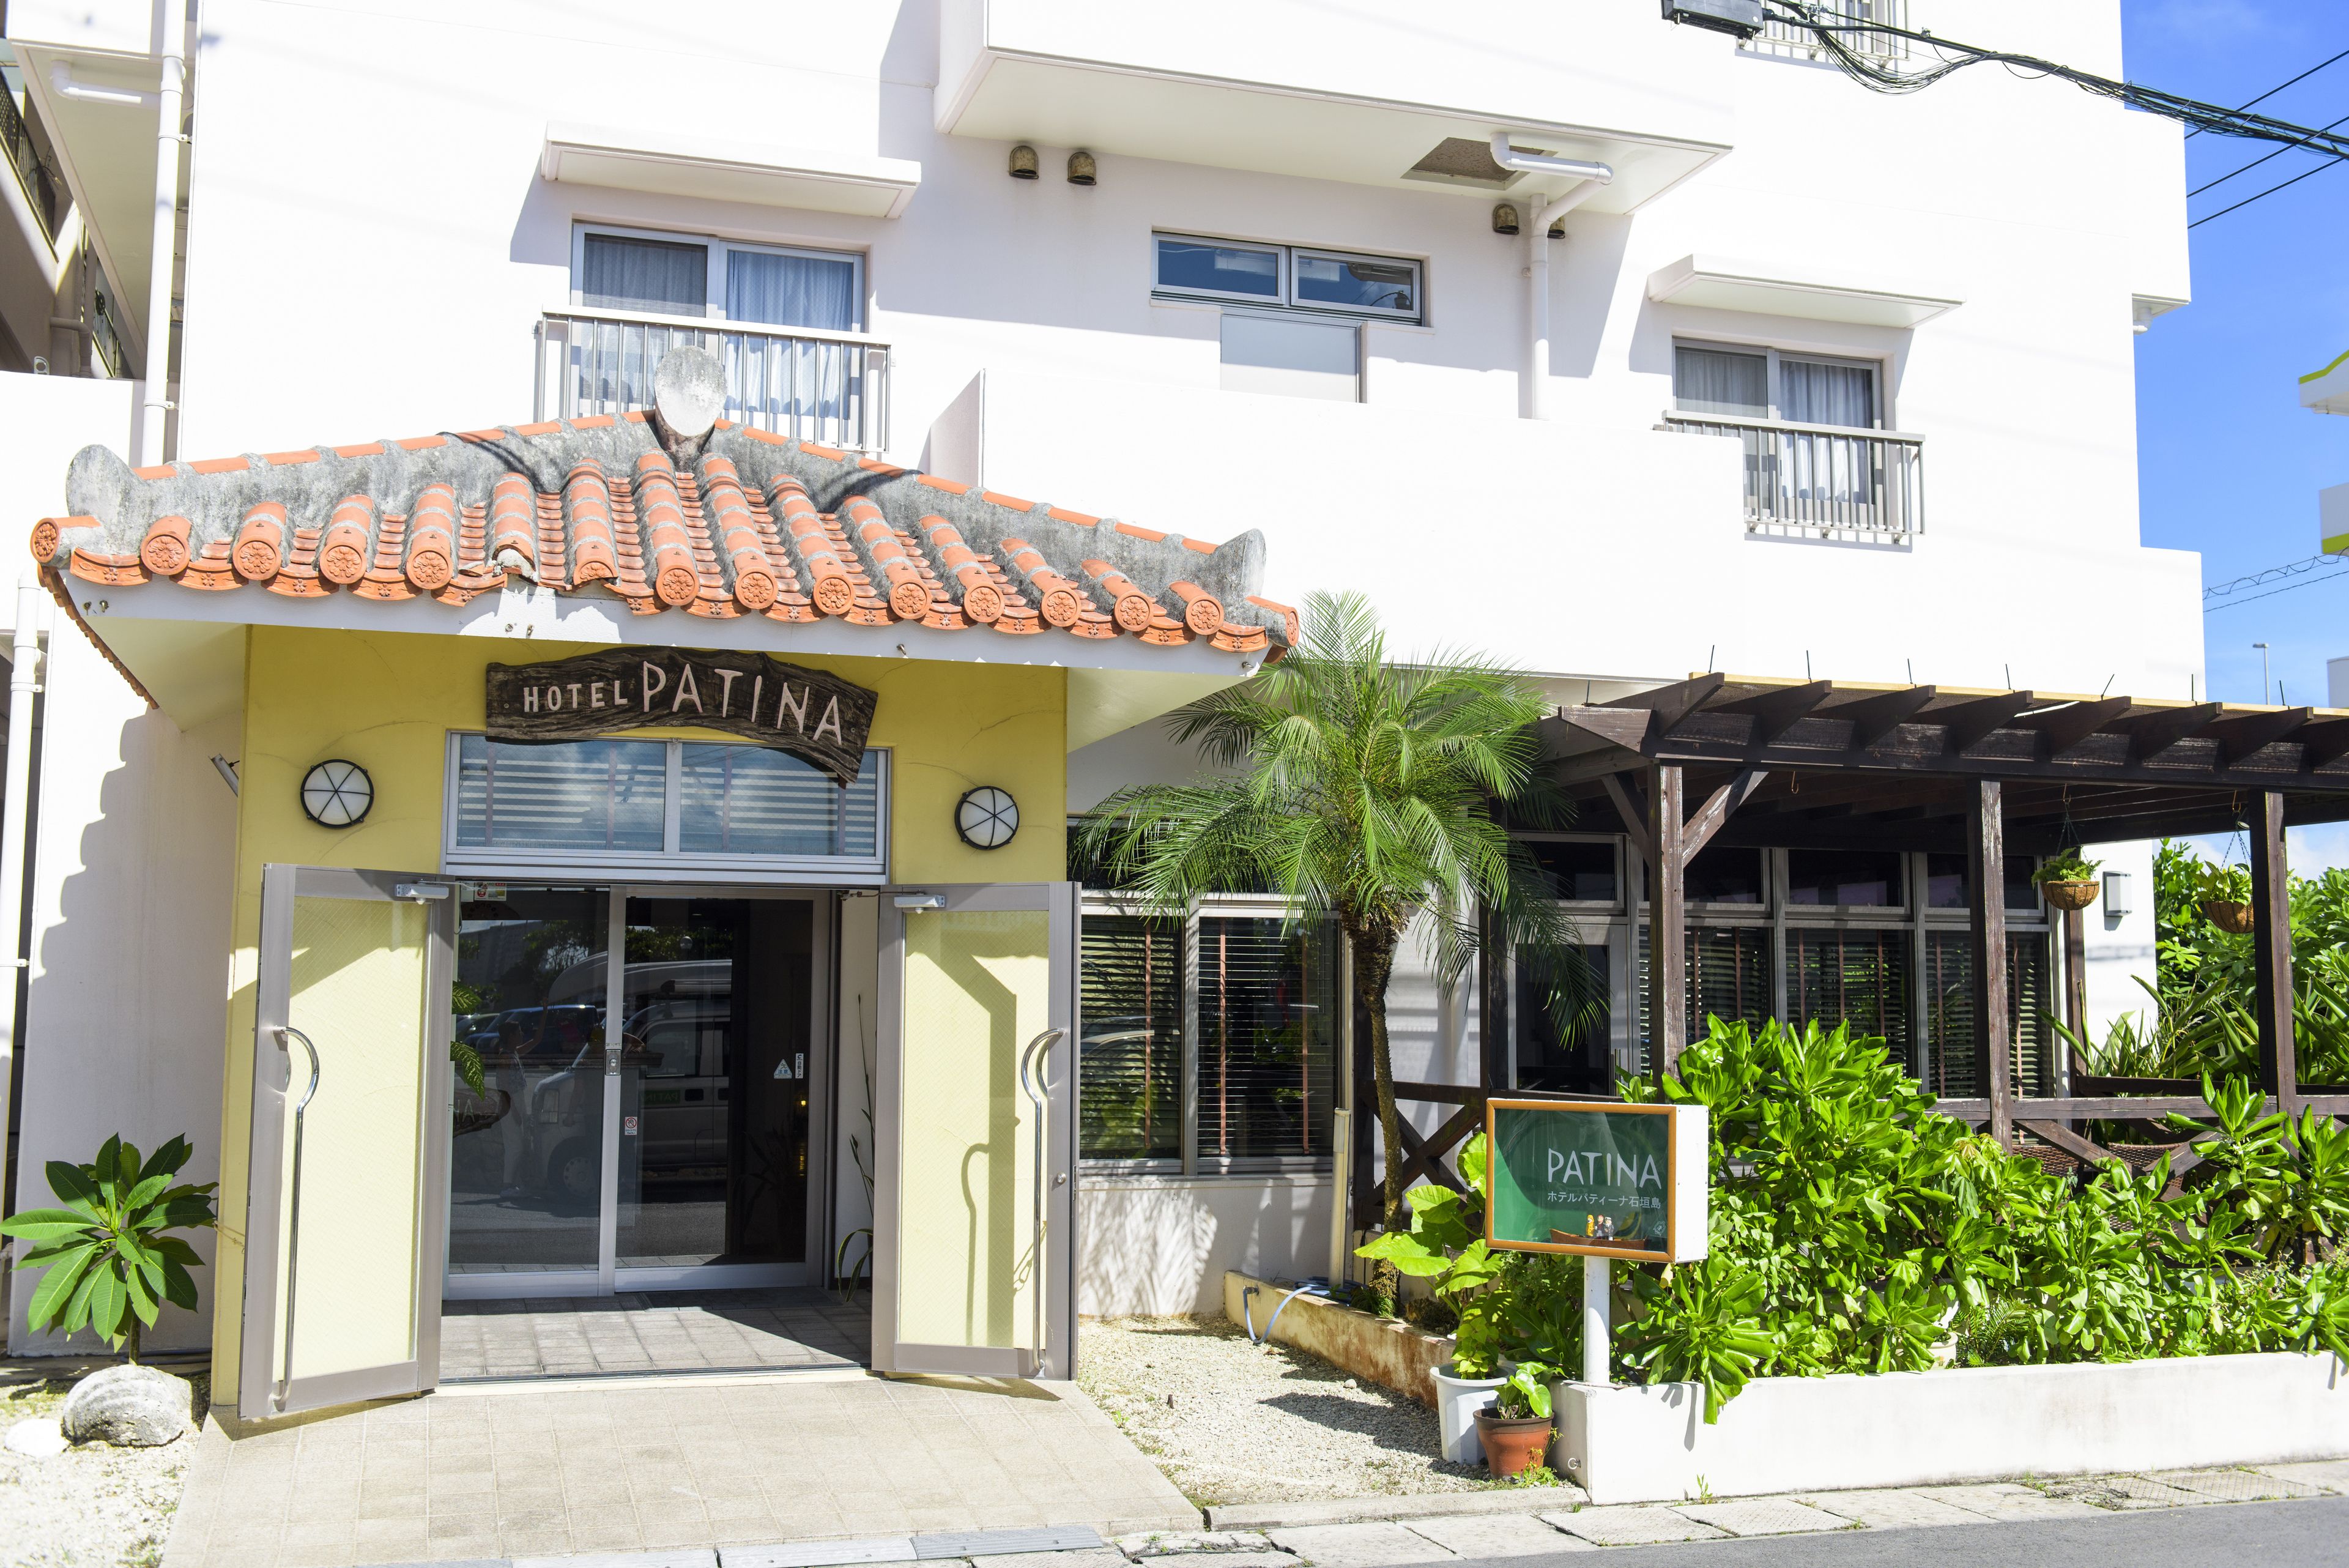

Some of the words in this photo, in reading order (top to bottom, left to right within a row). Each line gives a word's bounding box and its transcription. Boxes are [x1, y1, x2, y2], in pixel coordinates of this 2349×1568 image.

[524, 680, 628, 713] HOTEL
[644, 661, 842, 745] PATINA
[1548, 1148, 1662, 1189] PATINA
[1548, 1191, 1661, 1209] ホテルパティーナ石垣島
